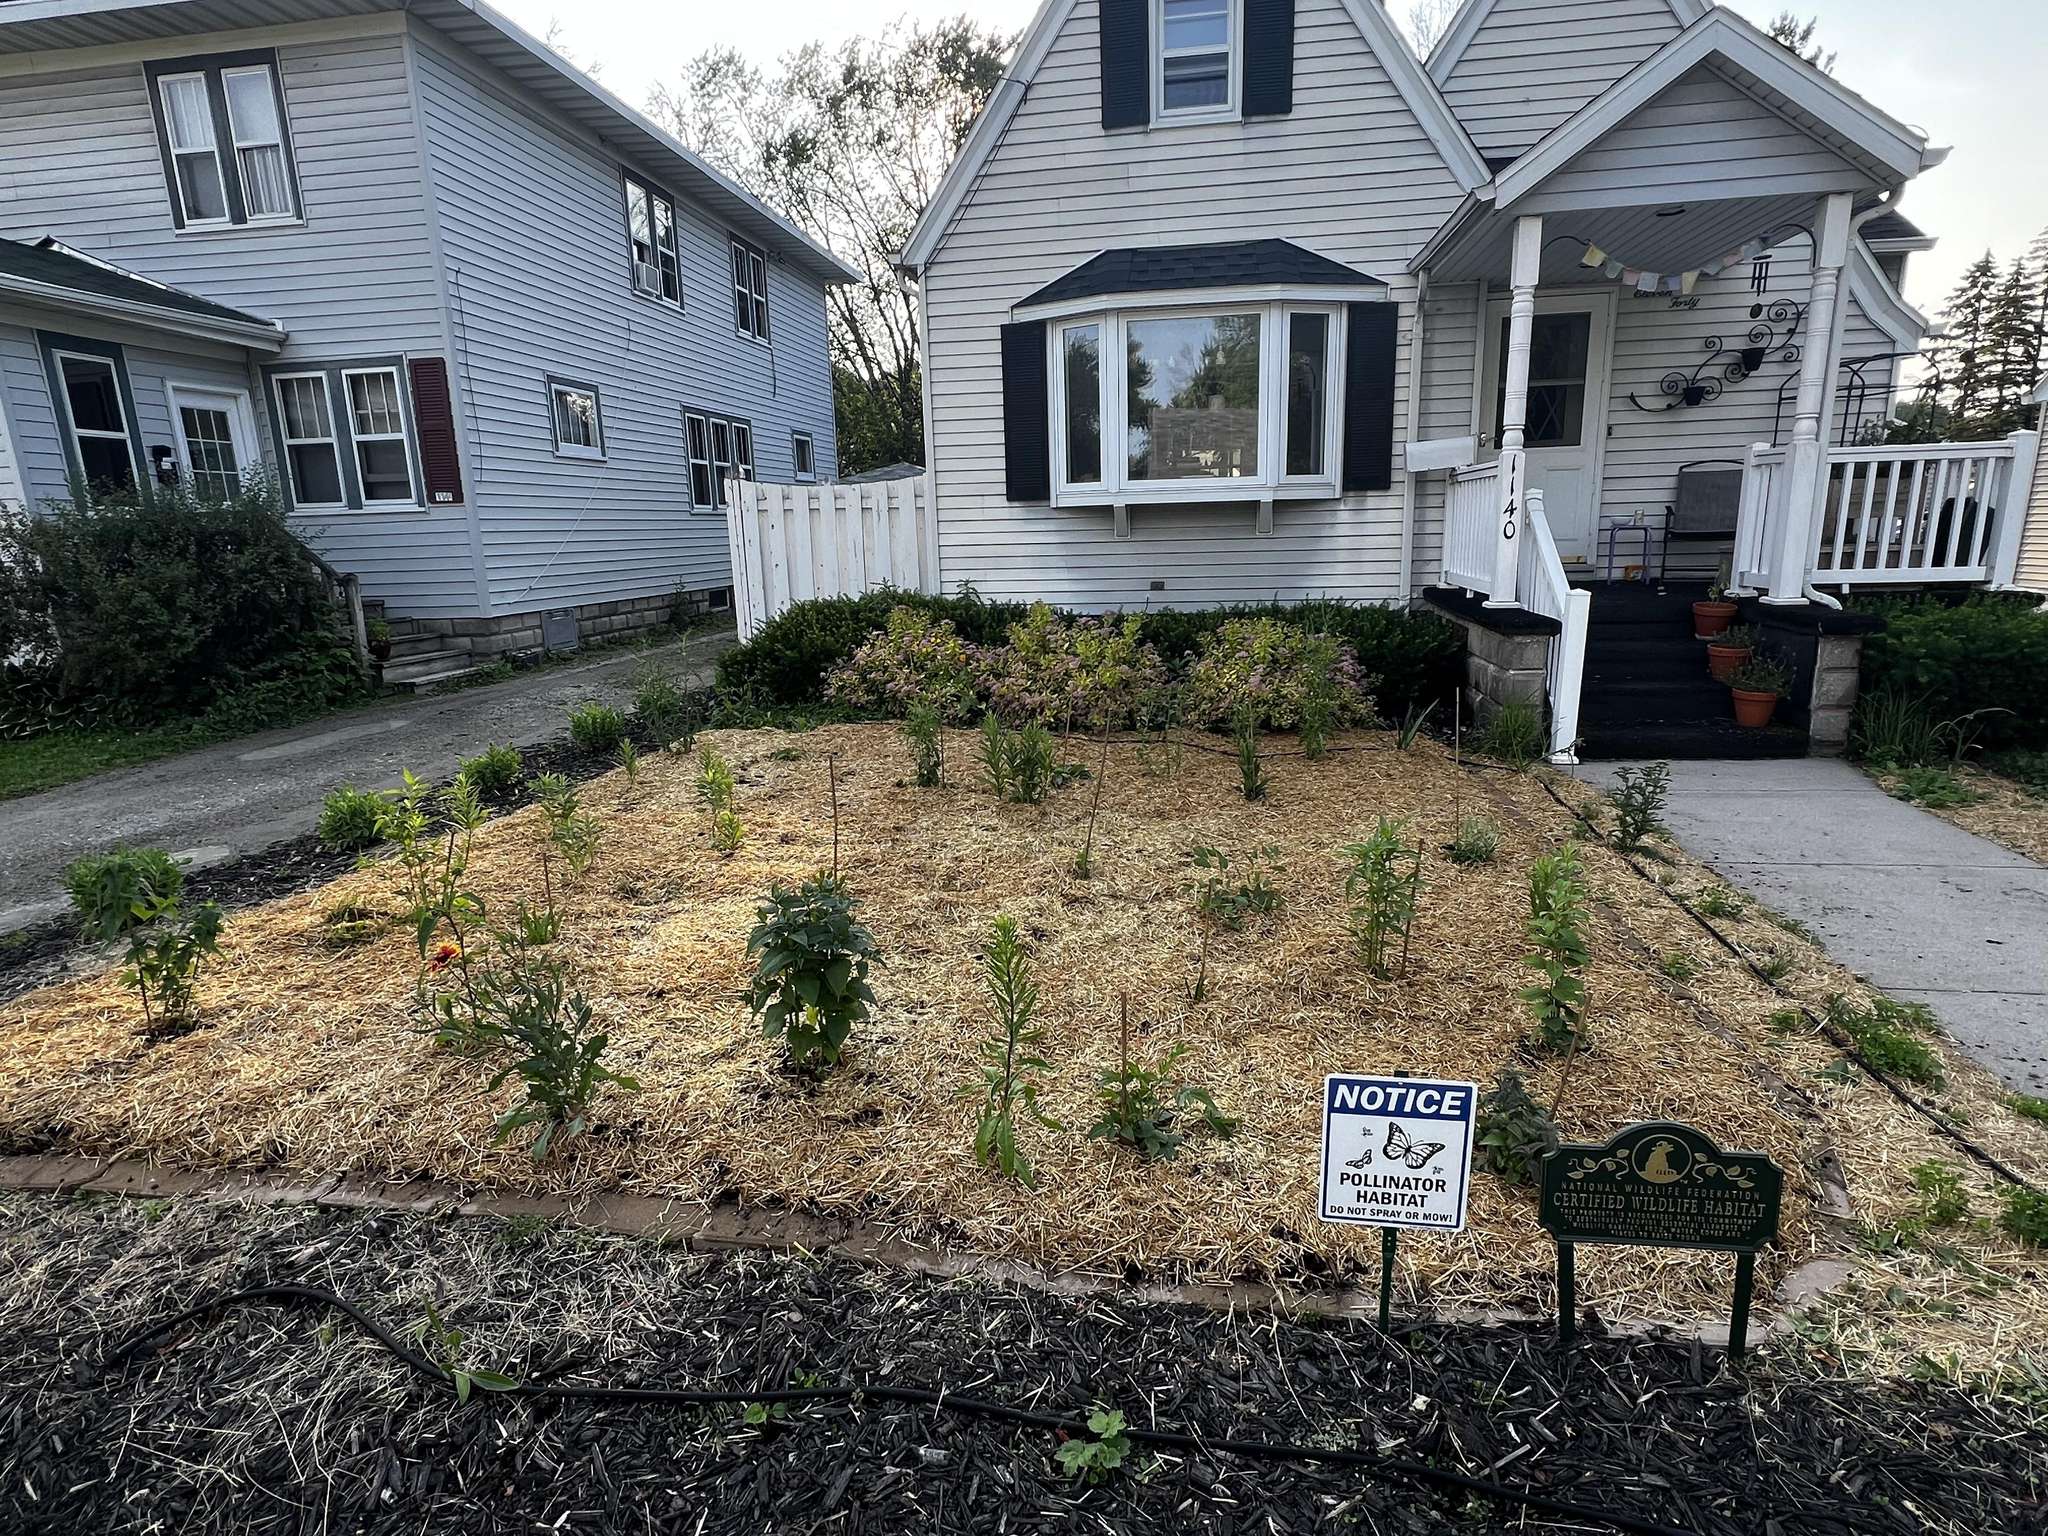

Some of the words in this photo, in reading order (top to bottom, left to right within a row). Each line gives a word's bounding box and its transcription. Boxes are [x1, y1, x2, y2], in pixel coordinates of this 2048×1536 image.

[1667, 296, 1701, 310] Forty
[1503, 454, 1517, 539] 1140
[1333, 1084, 1466, 1116] NOTICE
[1340, 1172, 1447, 1193] POLLINATOR
[1561, 1181, 1618, 1193] NATIONAL
[1625, 1184, 1680, 1196] WILDLIFE
[1687, 1187, 1760, 1201] FEDERATION
[1356, 1190, 1428, 1208] HABITAT
[1553, 1192, 1625, 1209] CERTIFIED
[1631, 1195, 1699, 1213] WILDLIFE
[1703, 1199, 1766, 1218] HABITAT
[1330, 1205, 1344, 1214] DO
[1347, 1206, 1367, 1216] NOT
[1369, 1208, 1402, 1219] SPRAY
[1405, 1211, 1419, 1220] OR
[1422, 1212, 1452, 1223] MOW!
